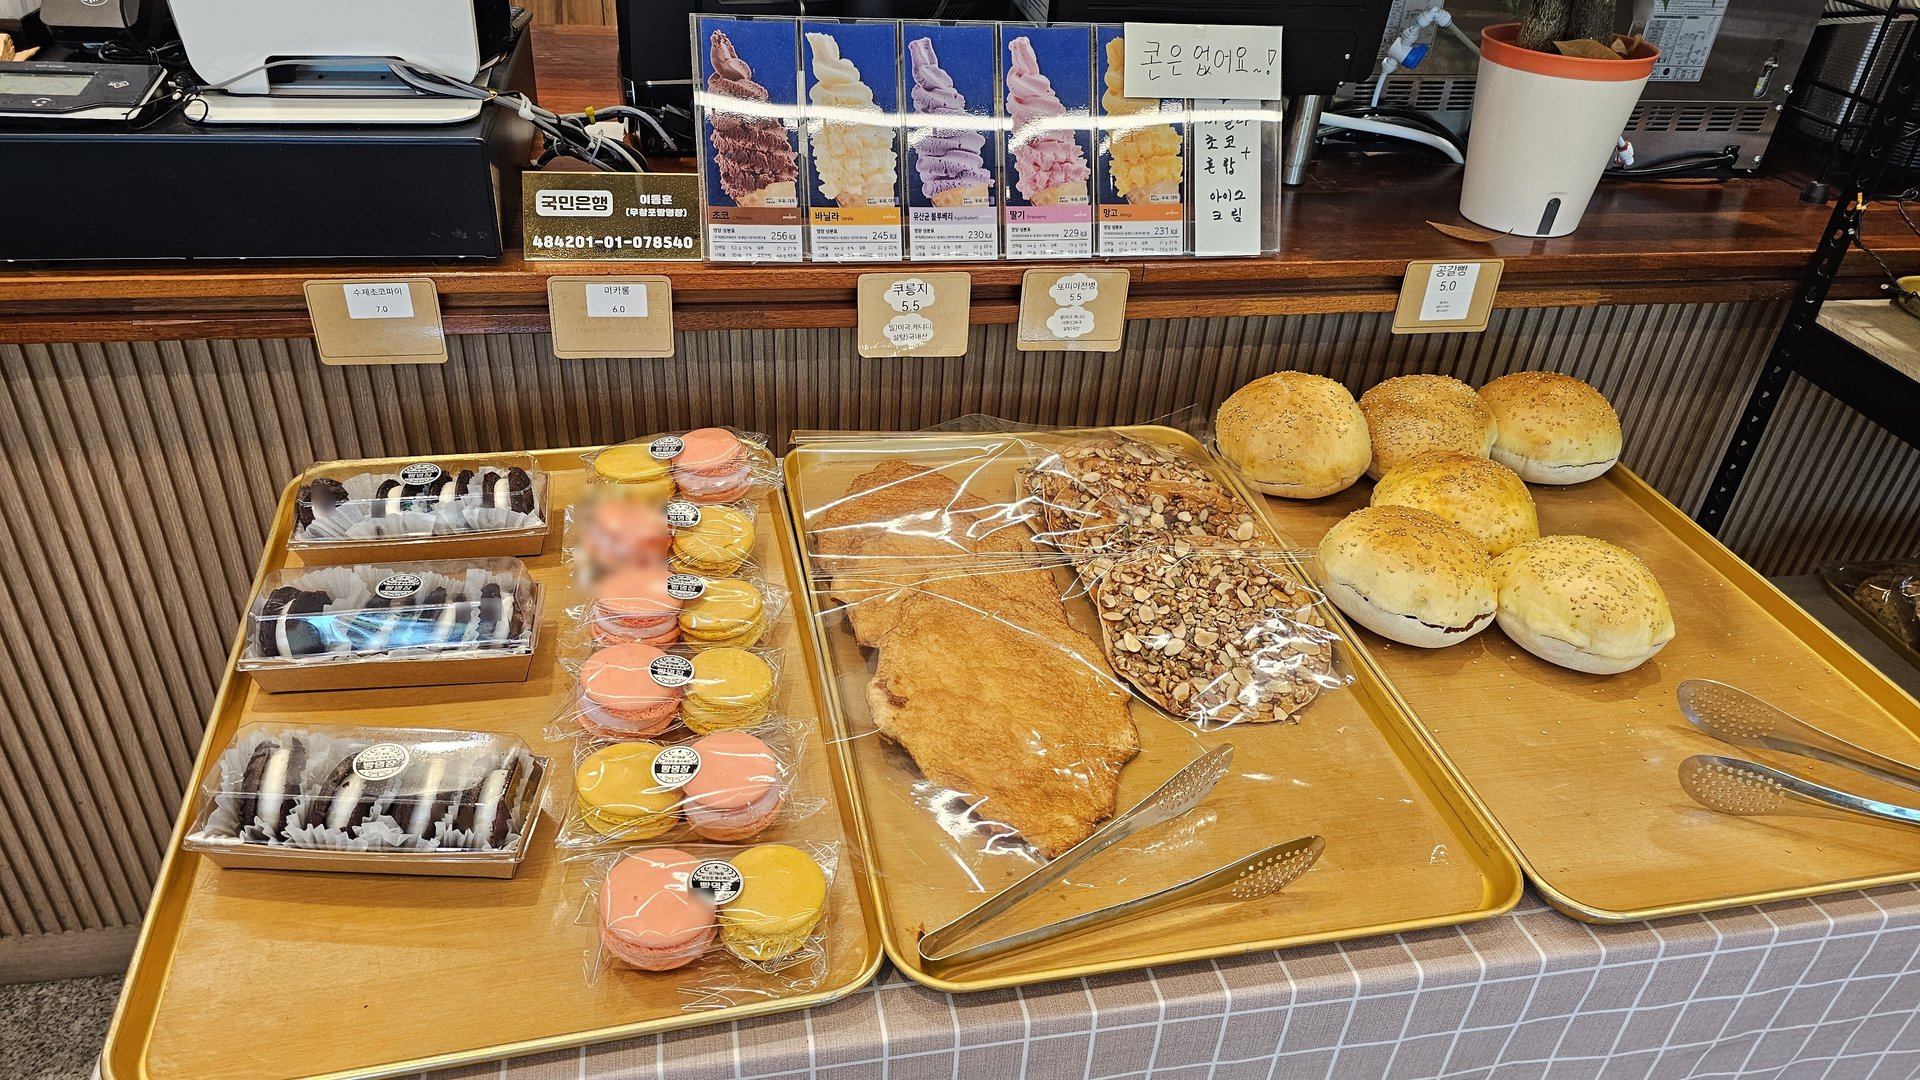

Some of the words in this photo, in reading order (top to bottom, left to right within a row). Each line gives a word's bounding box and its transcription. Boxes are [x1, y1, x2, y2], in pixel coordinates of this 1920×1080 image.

[1140, 40, 1183, 81] 콘은
[1205, 134, 1236, 150] 초코
[541, 195, 608, 211] 국민은행
[639, 194, 673, 205] 이동훈
[712, 211, 730, 220] 초코
[815, 211, 839, 222] 바닐라
[913, 212, 930, 221] 유산균
[1009, 210, 1025, 220] 딸기
[1103, 208, 1118, 218] 망고
[1212, 208, 1243, 223] 크림
[771, 232, 787, 240] 256
[968, 231, 983, 239] 230
[1064, 229, 1079, 237] 229
[1155, 227, 1168, 235] 231
[532, 235, 693, 249] 484201-01-078540
[1436, 265, 1468, 277] 공갈빵
[604, 286, 630, 296] 마카롱
[1439, 281, 1457, 291] 5.0
[353, 287, 403, 296] 수제초코파이
[1070, 293, 1082, 301] 5.5
[376, 305, 388, 313] 7.0
[902, 300, 920, 311] 5.5
